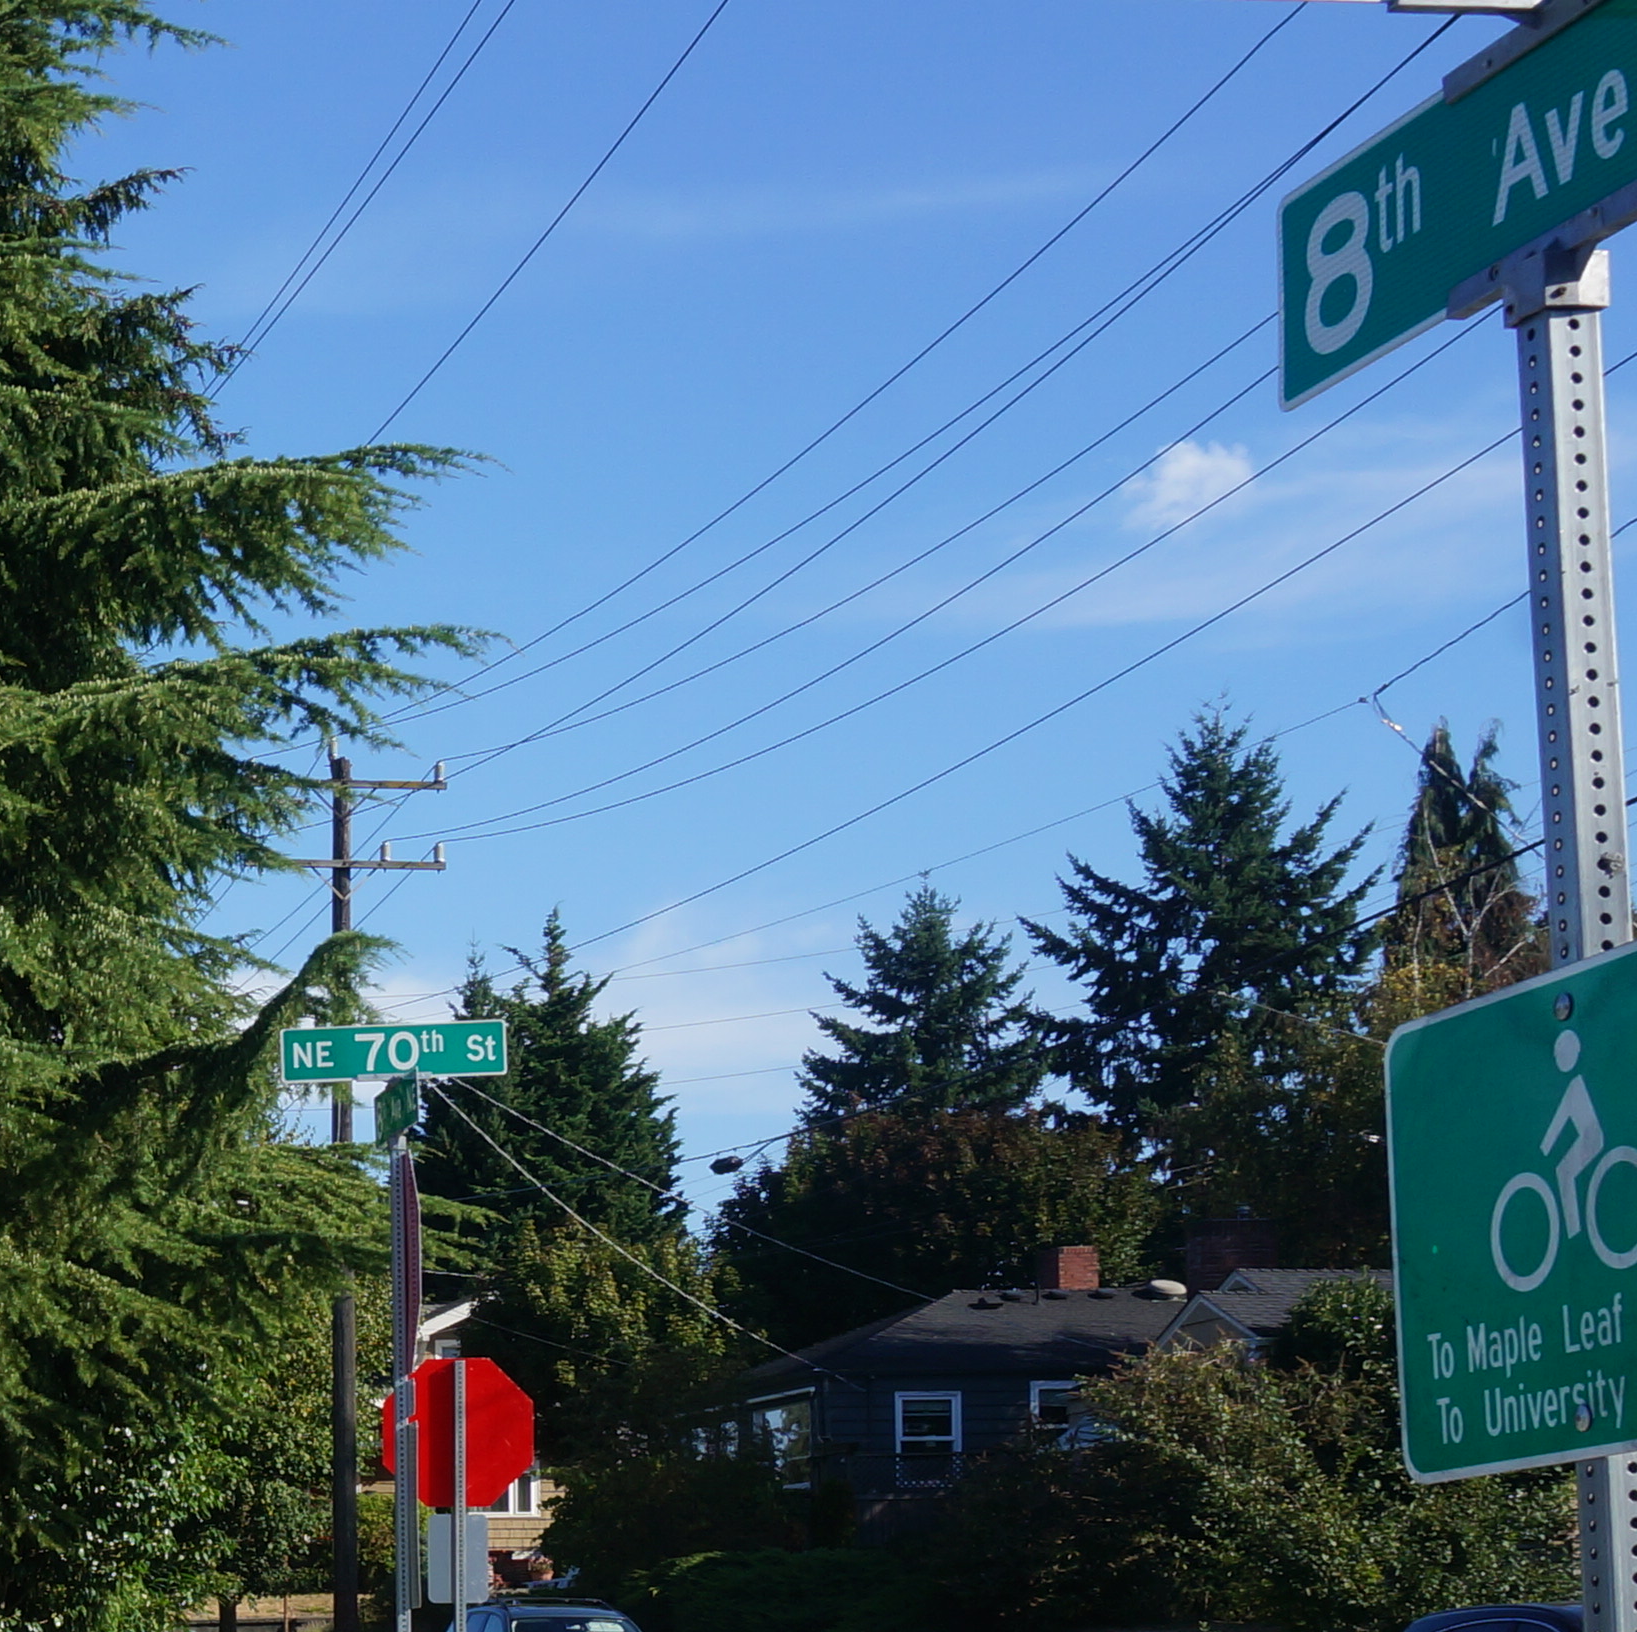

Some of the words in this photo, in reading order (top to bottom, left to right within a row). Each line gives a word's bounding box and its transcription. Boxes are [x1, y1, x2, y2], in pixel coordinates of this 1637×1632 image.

[1304, 152, 1422, 355] 8th
[1492, 69, 1629, 227] Ave
[292, 1040, 334, 1069] NE
[354, 1029, 444, 1072] 70th
[466, 1034, 496, 1061] St
[1427, 1332, 1454, 1380] To
[1466, 1315, 1543, 1379] Maple
[1562, 1291, 1623, 1354] Leaf
[1436, 1396, 1464, 1445] To
